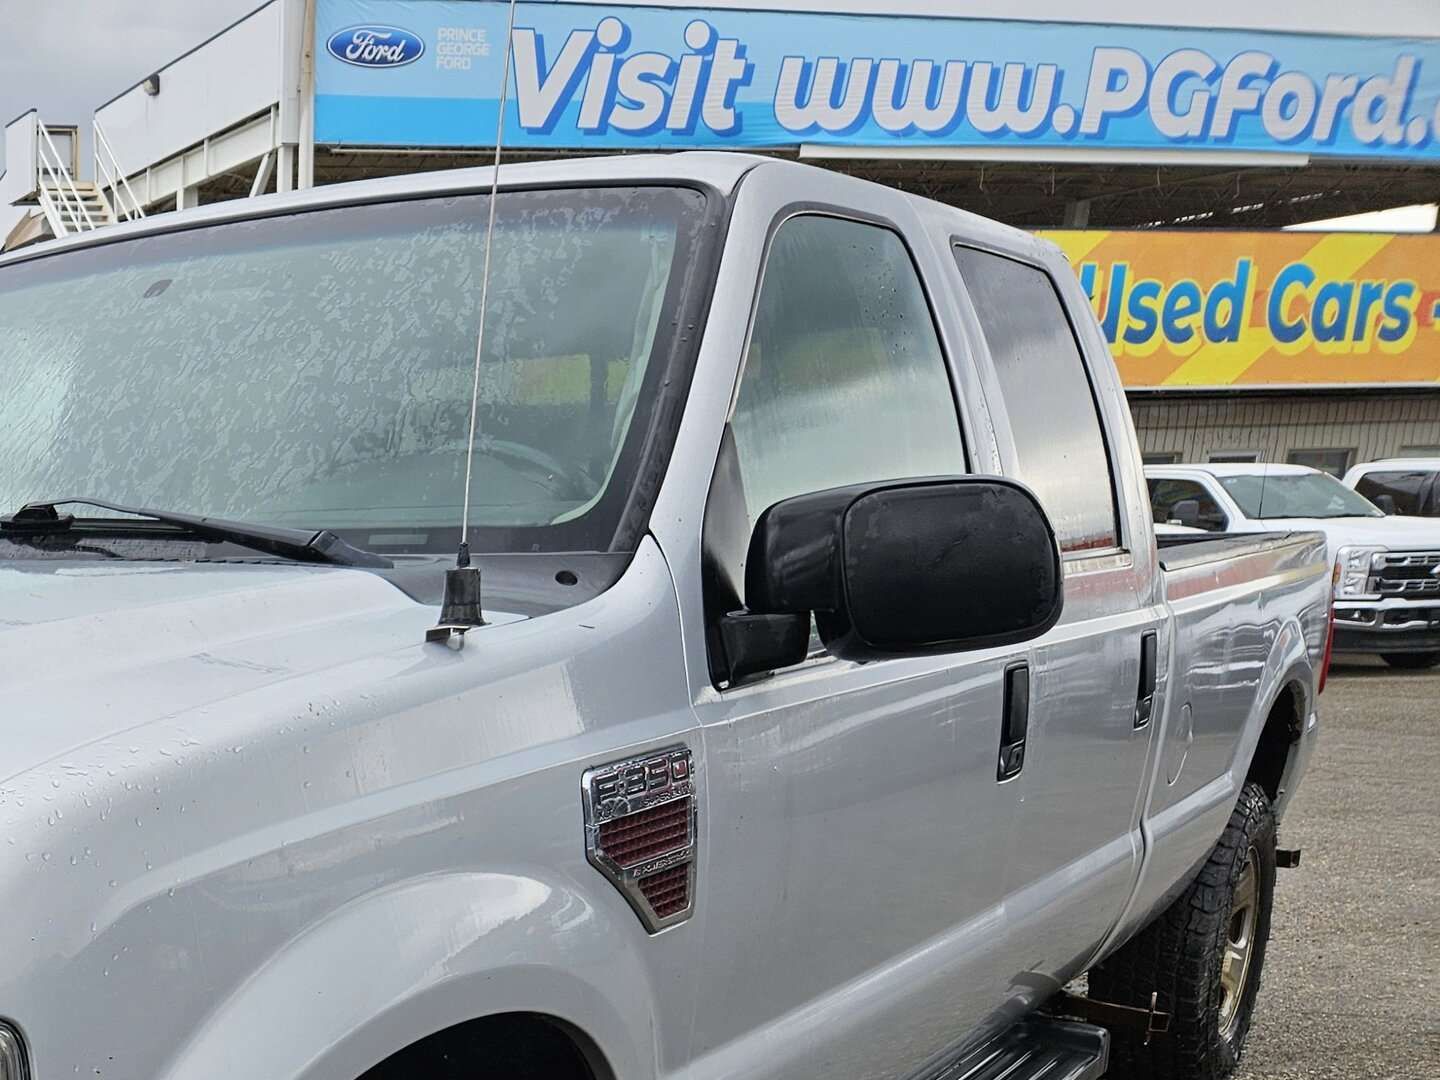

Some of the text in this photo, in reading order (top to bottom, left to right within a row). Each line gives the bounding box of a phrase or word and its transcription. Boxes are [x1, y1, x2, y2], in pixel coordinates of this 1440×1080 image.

[345, 29, 407, 62] Ford
[437, 27, 487, 42] PRINCE
[436, 43, 491, 57] GEORGE
[436, 57, 472, 71] FORD
[511, 16, 1440, 145] Visit www.PGFord.
[1080, 259, 1417, 345] Used Cars
